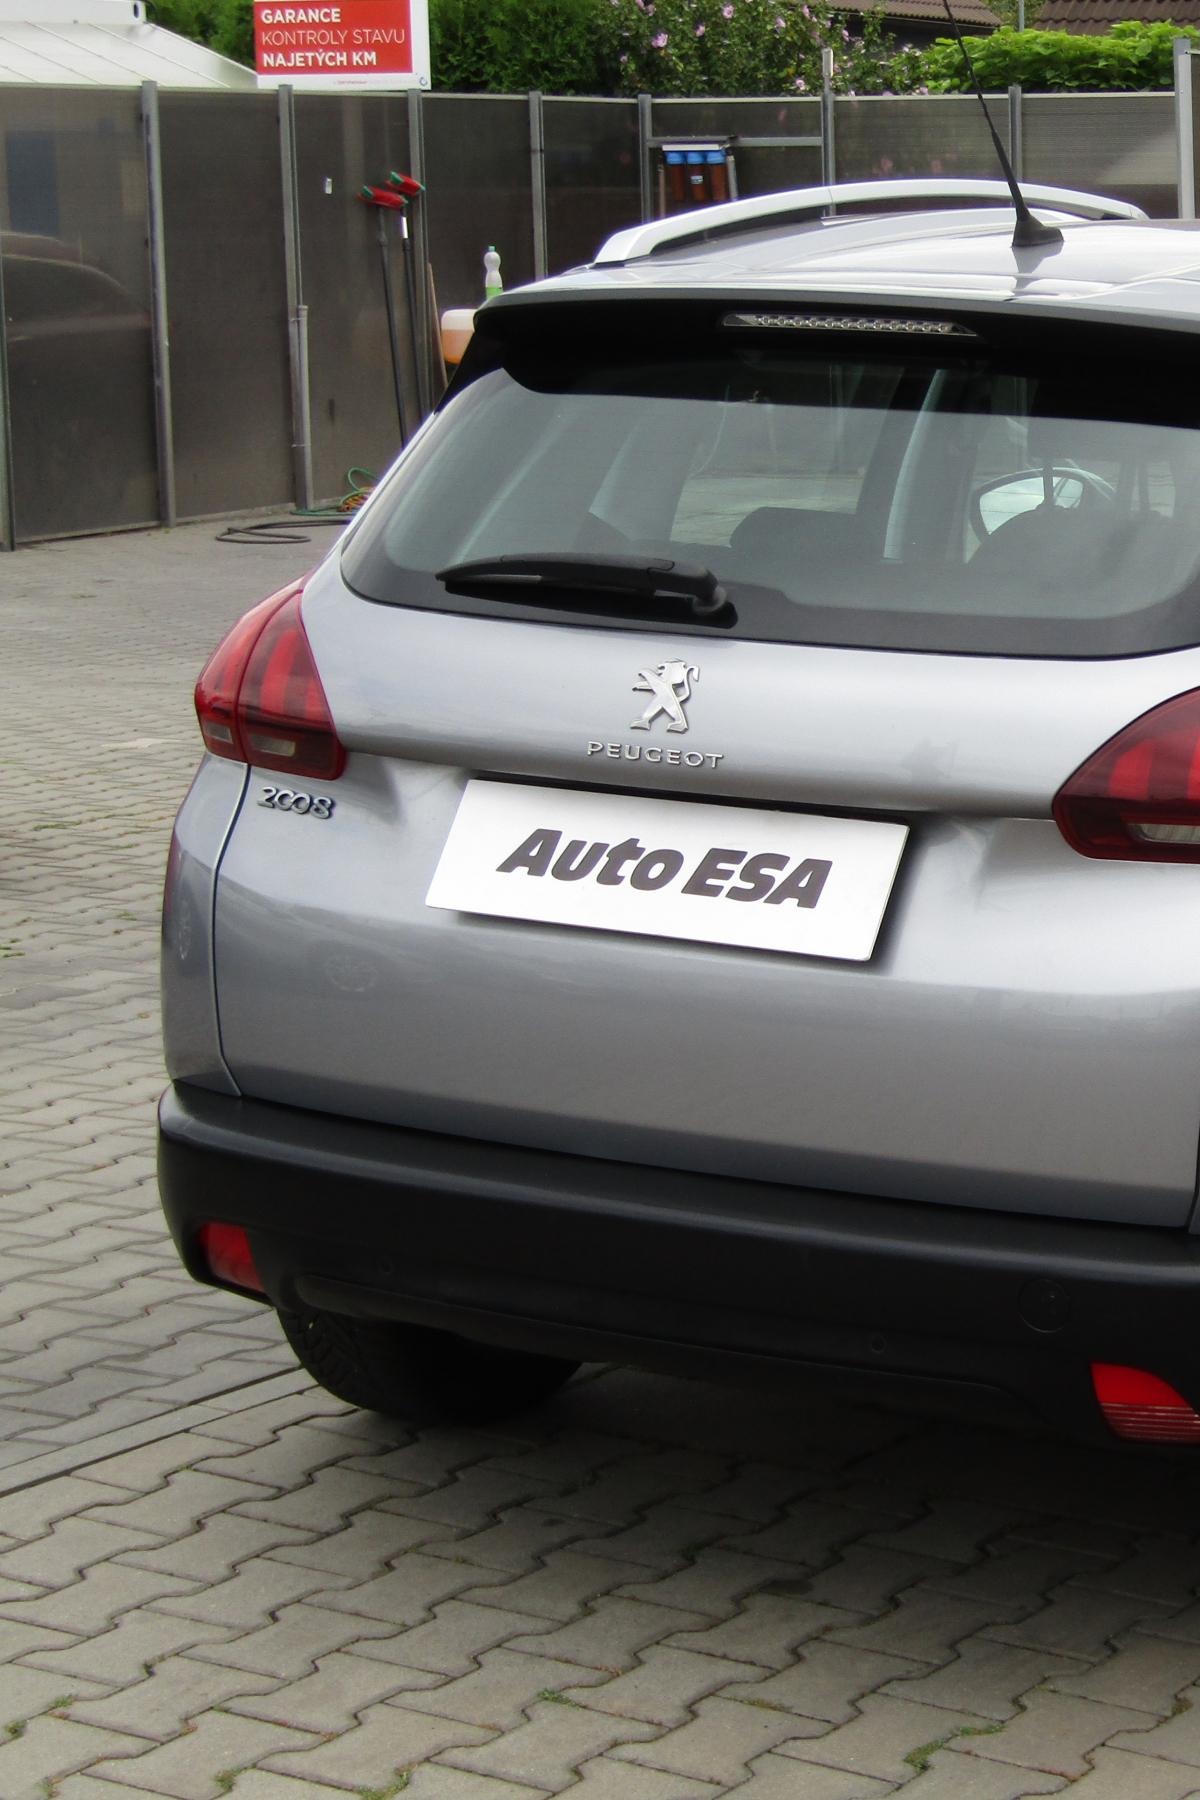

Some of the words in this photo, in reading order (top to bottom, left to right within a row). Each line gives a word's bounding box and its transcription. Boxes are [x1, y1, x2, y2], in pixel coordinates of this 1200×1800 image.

[261, 8, 341, 24] GARANCE
[262, 30, 348, 46] KONTROLY
[353, 29, 405, 44] STAVU
[263, 49, 348, 67] NAJETÝCH
[352, 51, 377, 66] KM
[587, 741, 724, 769] PEUGEOT
[257, 787, 334, 820] 2008
[496, 828, 685, 891] Auto
[681, 848, 833, 909] ESA
